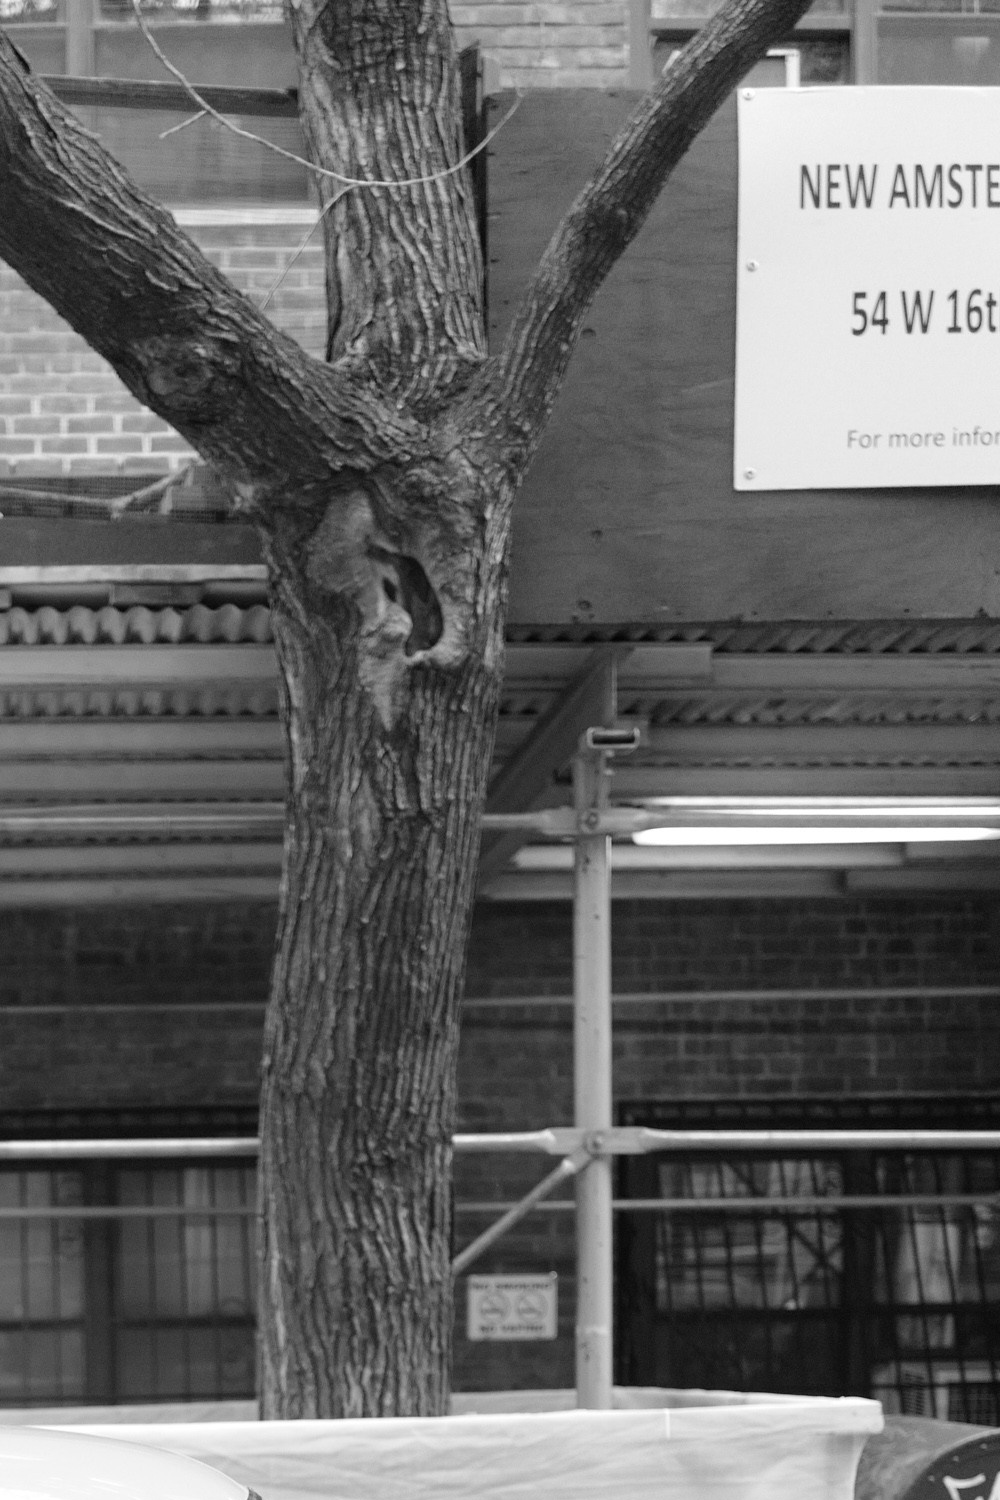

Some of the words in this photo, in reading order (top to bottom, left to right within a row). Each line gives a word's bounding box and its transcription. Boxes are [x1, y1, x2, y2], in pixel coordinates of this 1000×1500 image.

[799, 164, 878, 209] NEW
[888, 164, 1000, 209] AMSTE
[851, 291, 889, 336] 54
[900, 290, 935, 334] W
[847, 430, 881, 449] For
[888, 432, 945, 448] more
